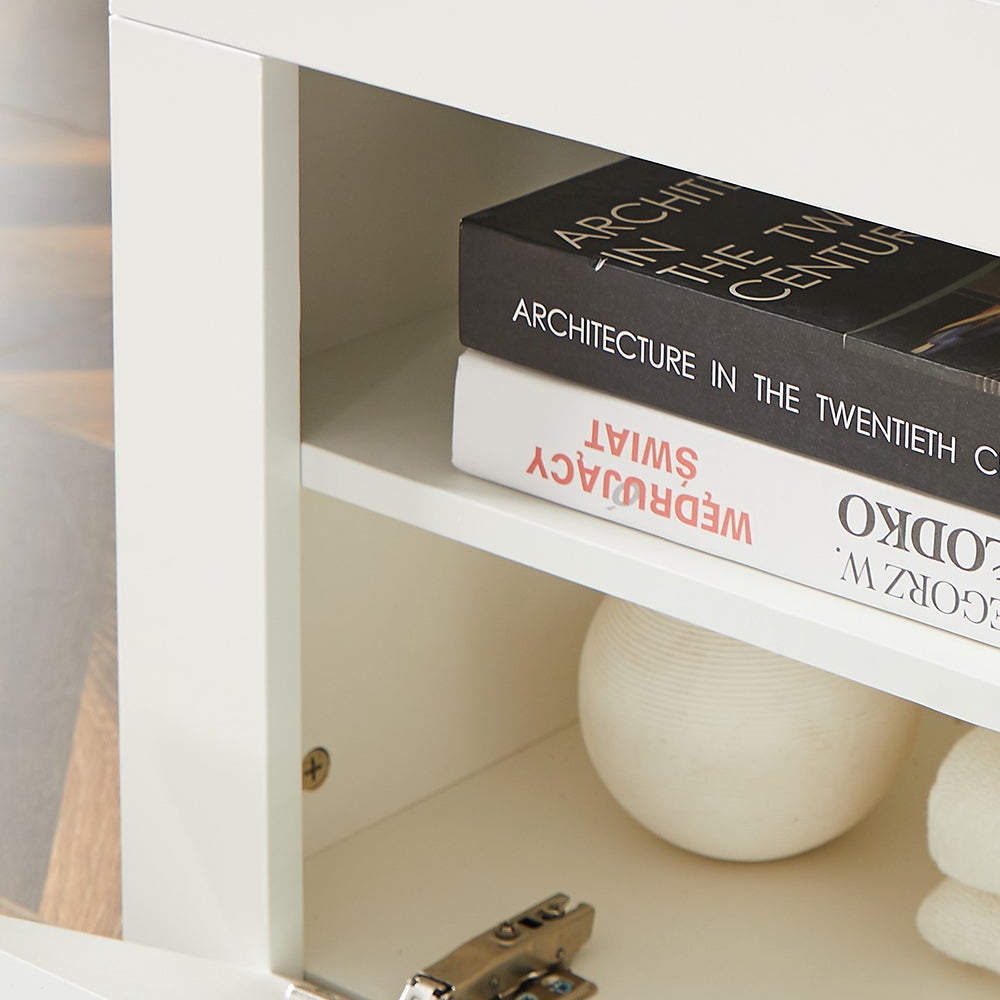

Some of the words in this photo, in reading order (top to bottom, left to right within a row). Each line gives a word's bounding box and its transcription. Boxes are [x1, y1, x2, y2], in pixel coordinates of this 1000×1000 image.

[601, 237, 684, 266] IN
[656, 245, 773, 283] THE
[512, 298, 696, 380] ARCHITECTURE
[711, 360, 736, 393] IN
[753, 373, 800, 414] THE
[816, 393, 956, 464] TWENTIETH
[584, 419, 699, 487] ŚWIAT
[526, 446, 753, 545] WĘDRUJĄCY
[836, 547, 876, 591] W.
